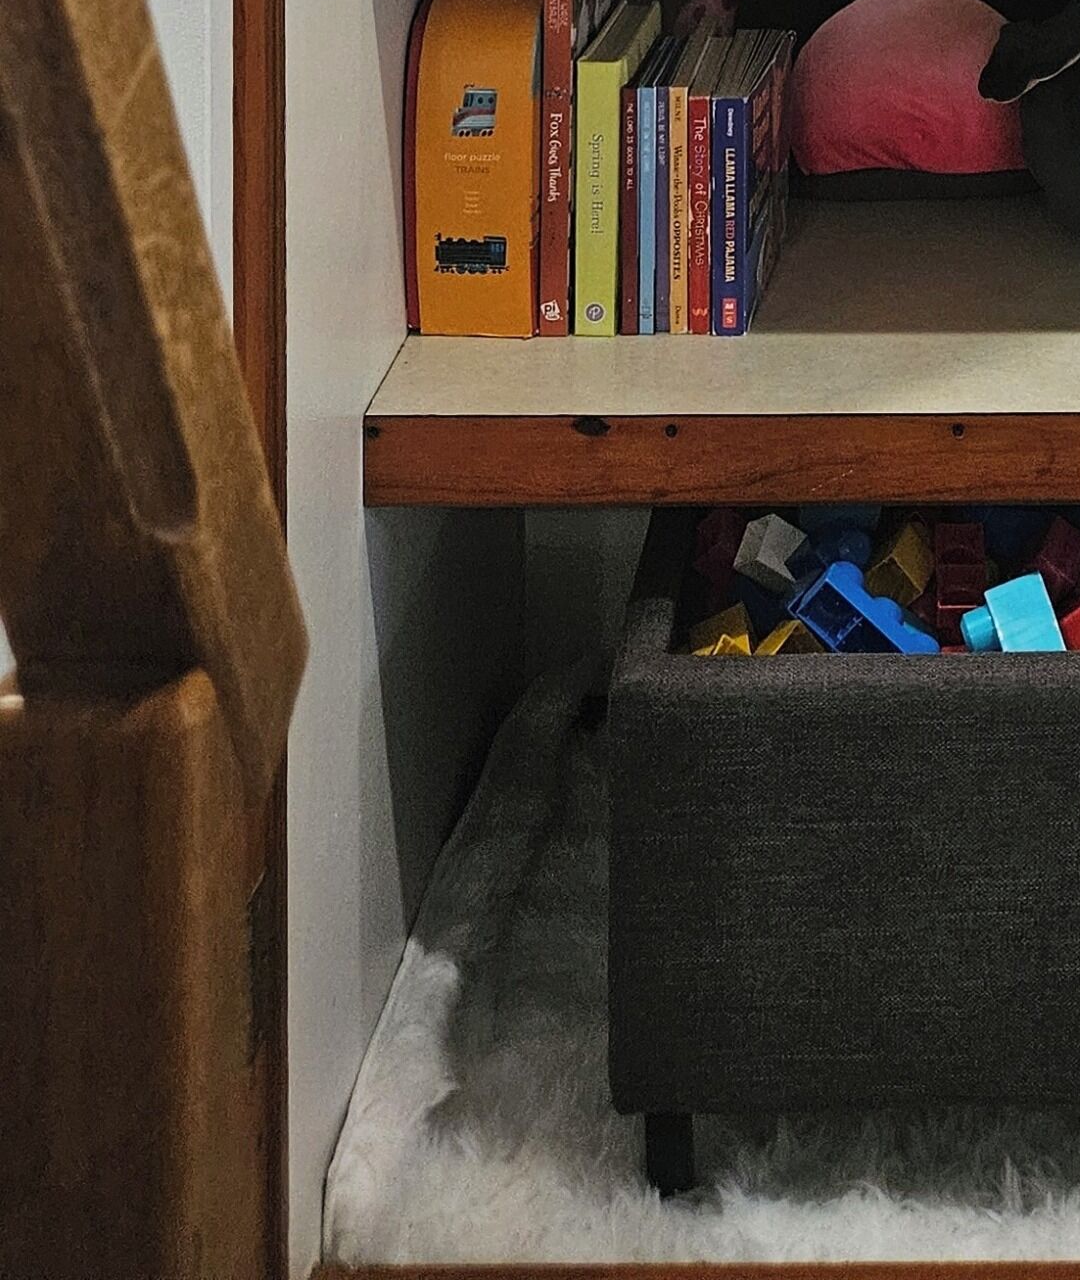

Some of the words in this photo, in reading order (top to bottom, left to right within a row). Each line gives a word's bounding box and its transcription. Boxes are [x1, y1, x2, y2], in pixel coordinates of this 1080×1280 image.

[674, 96, 682, 122] MILNE
[550, 112, 563, 138] Fox
[694, 116, 707, 141] The
[726, 108, 734, 138] Dewdney
[548, 140, 562, 164] Gives
[626, 136, 634, 144] IS
[444, 152, 467, 161] floor
[469, 152, 501, 162] puzzle
[588, 134, 604, 178] Spring
[626, 146, 634, 165] GOOD
[692, 144, 706, 178] Story
[725, 148, 735, 183] LLAMA
[548, 168, 562, 202] Thanks
[626, 168, 634, 176] TO
[626, 178, 634, 191] ALL
[592, 184, 604, 194] is
[694, 183, 707, 196] of
[725, 183, 735, 218] LLAMA
[591, 201, 604, 234] Here!
[726, 220, 735, 240] RED
[695, 200, 708, 266] CHRISTMAS
[673, 220, 681, 280] OPPOSITES
[725, 240, 735, 282] PAJAMA
